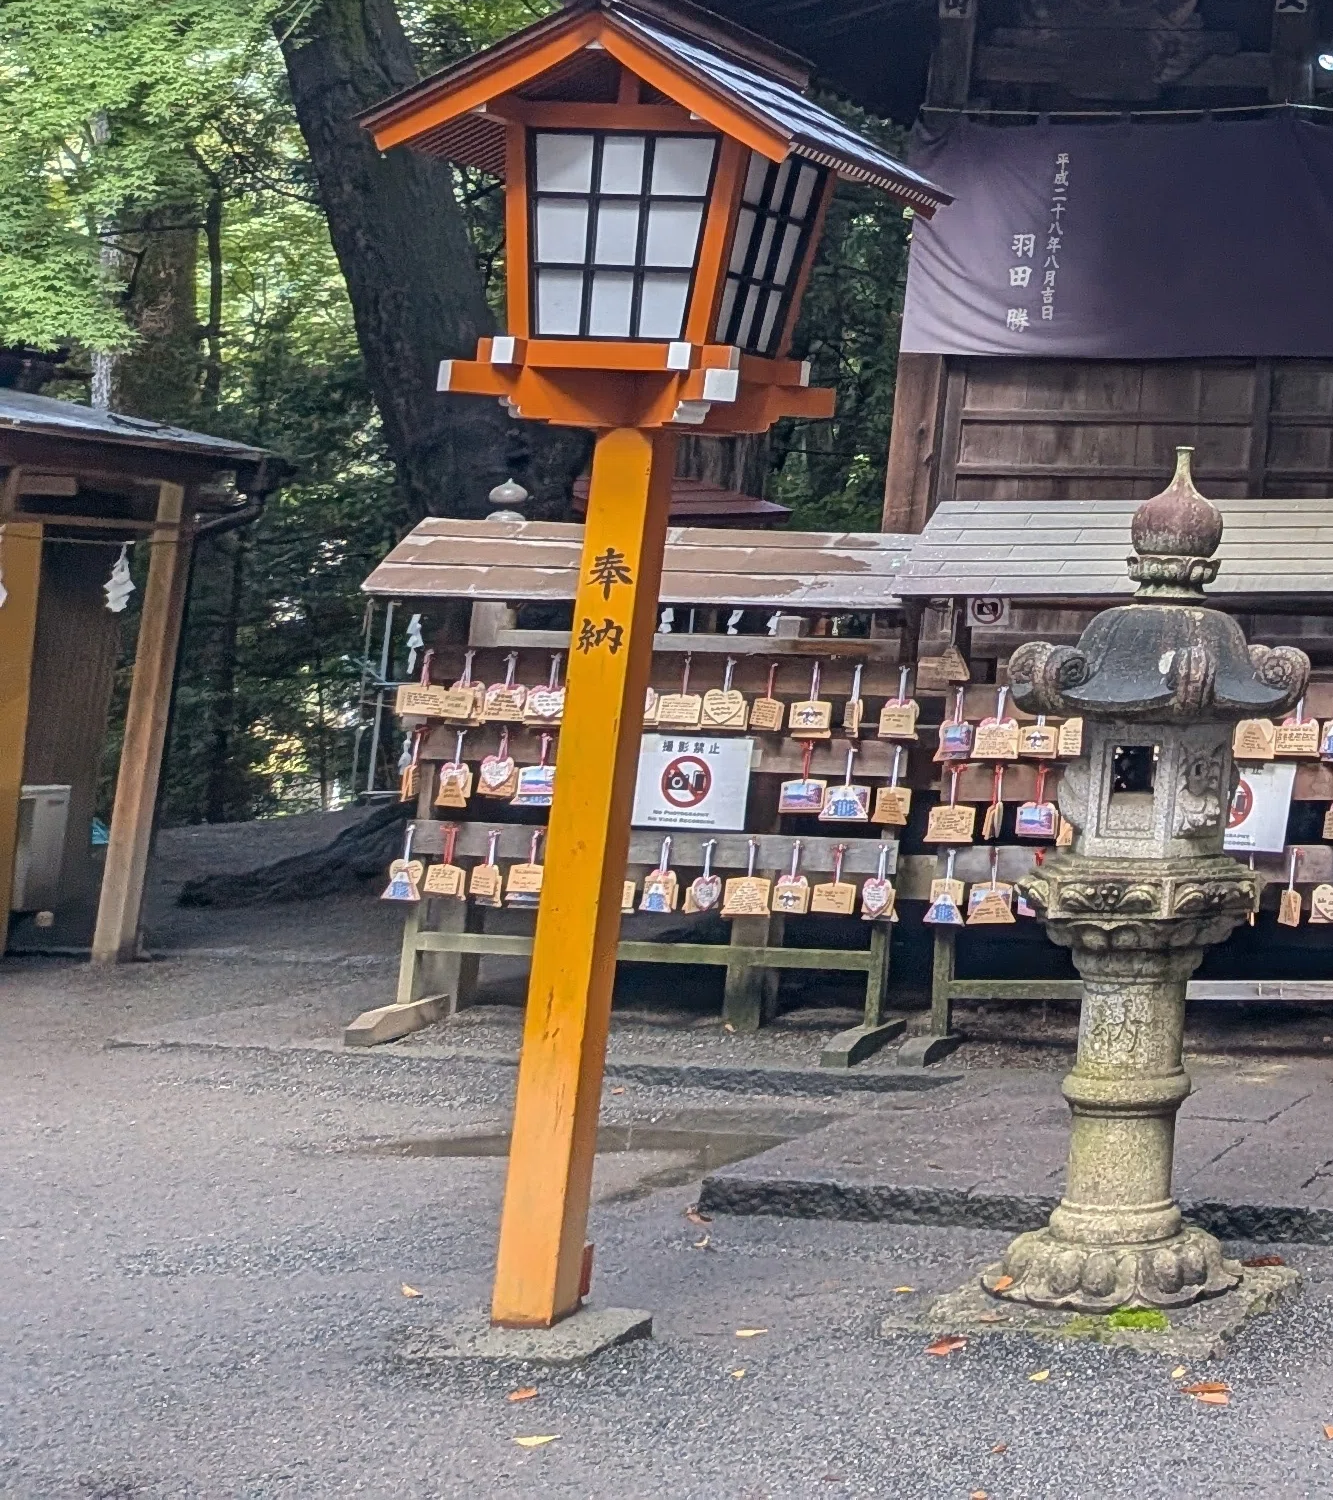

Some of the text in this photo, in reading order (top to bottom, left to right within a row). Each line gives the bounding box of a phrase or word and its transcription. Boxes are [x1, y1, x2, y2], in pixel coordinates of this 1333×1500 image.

[1040, 152, 1070, 321] 平成二十八年八月吉日
[577, 546, 633, 656] 奉納
[662, 739, 721, 755] 撮影禁止
